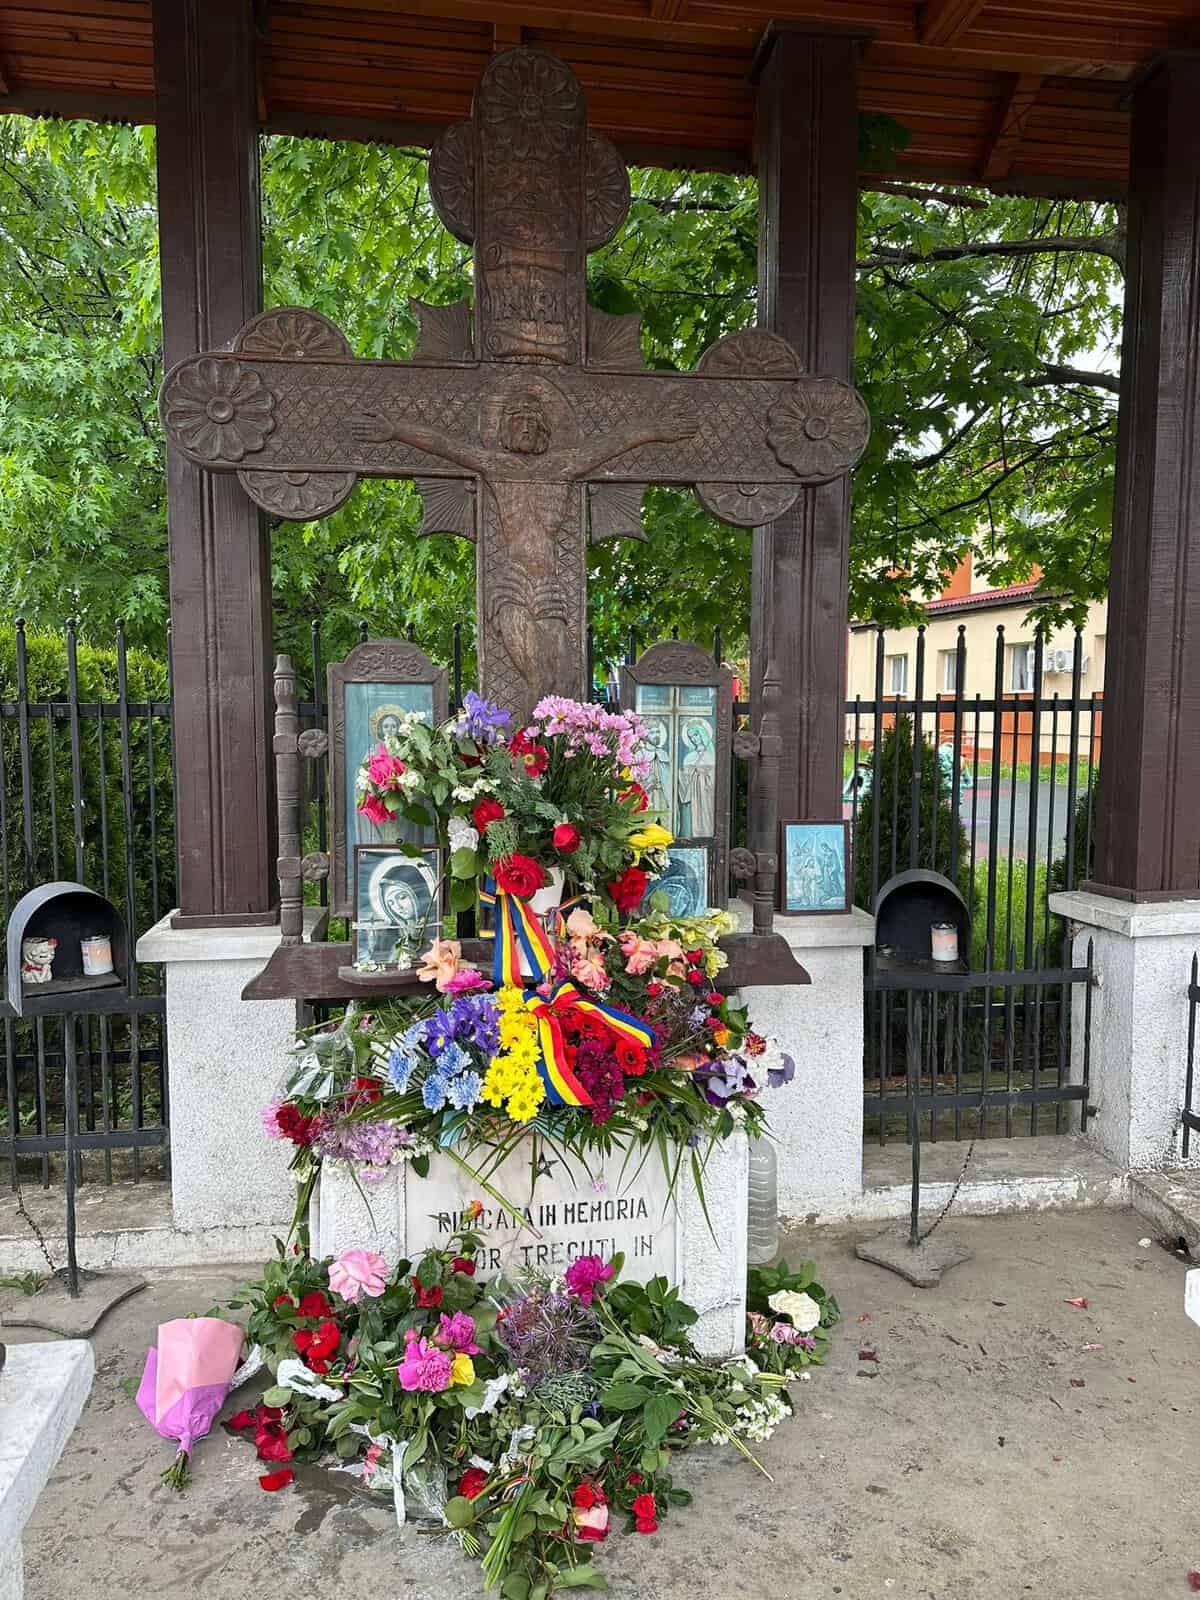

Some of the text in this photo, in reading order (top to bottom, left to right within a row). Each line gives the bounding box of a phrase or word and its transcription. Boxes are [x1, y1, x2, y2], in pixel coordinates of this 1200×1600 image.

[539, 1204, 556, 1227] IN
[563, 1197, 649, 1225] MEMORIA
[634, 1234, 654, 1257] IN
